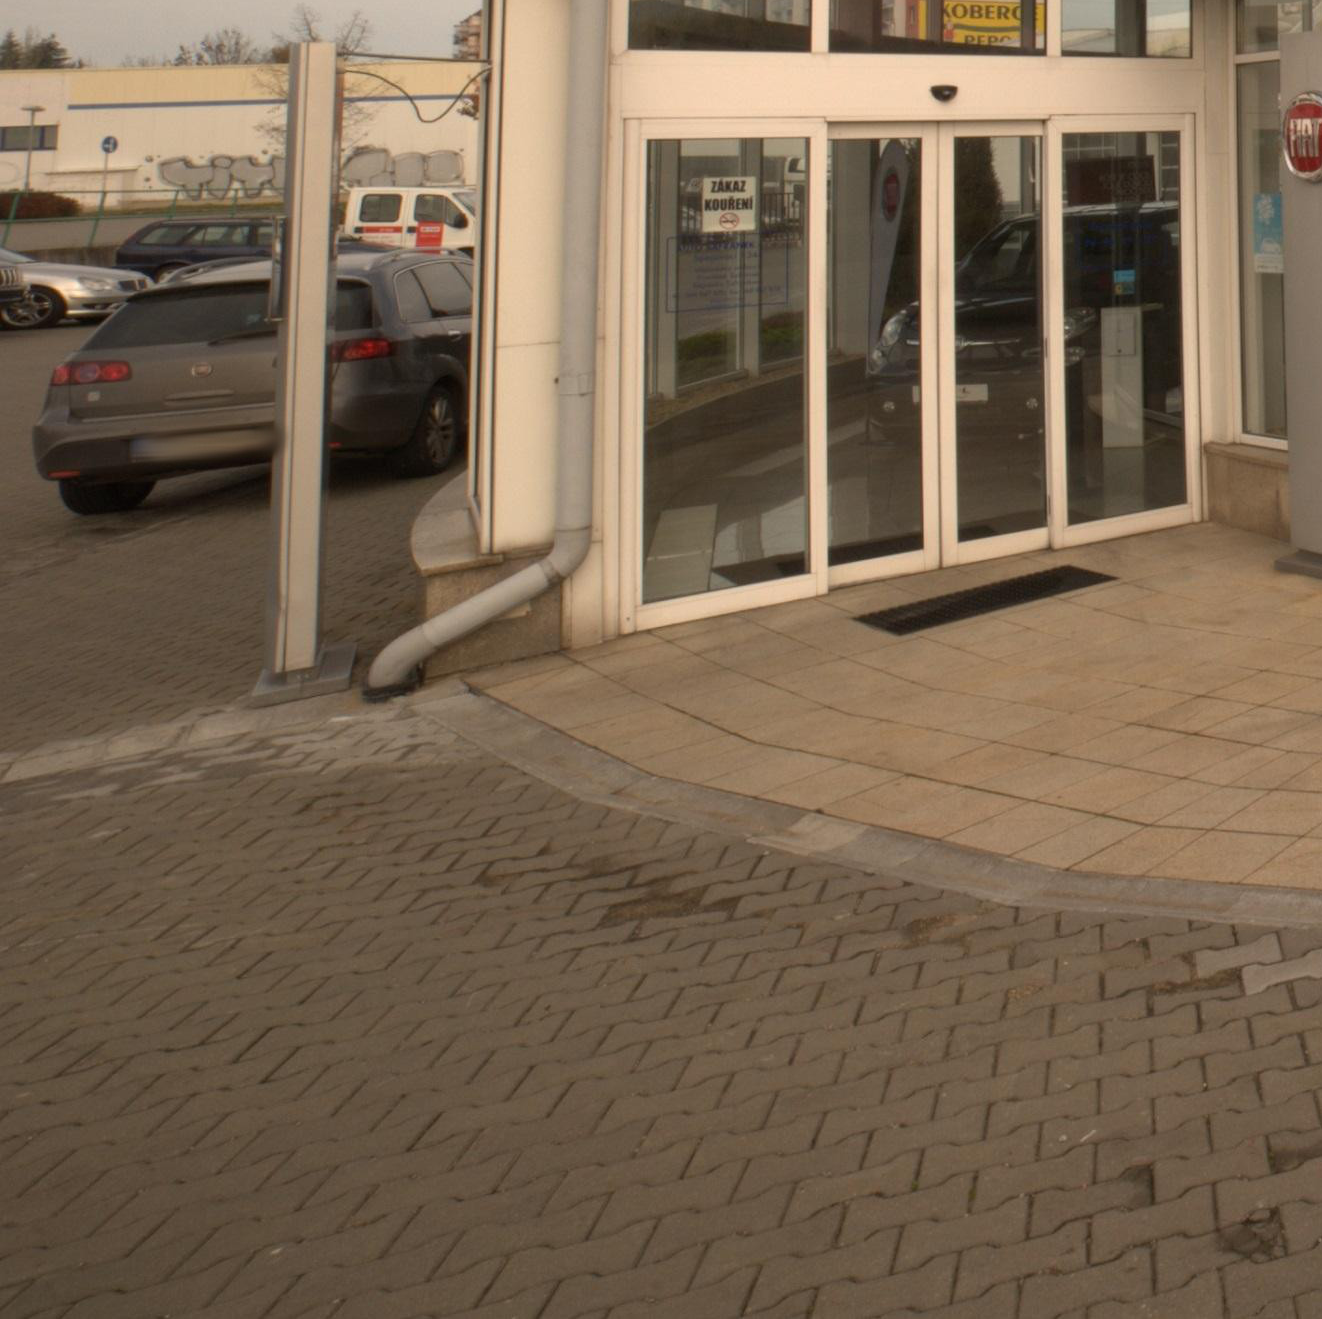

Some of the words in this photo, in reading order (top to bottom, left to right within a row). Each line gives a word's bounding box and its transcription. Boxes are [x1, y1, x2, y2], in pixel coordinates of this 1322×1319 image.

[1289, 118, 1322, 158] FIAT
[711, 178, 746, 193] ZÁKAZ
[704, 195, 753, 211] KOUŘENÍ
